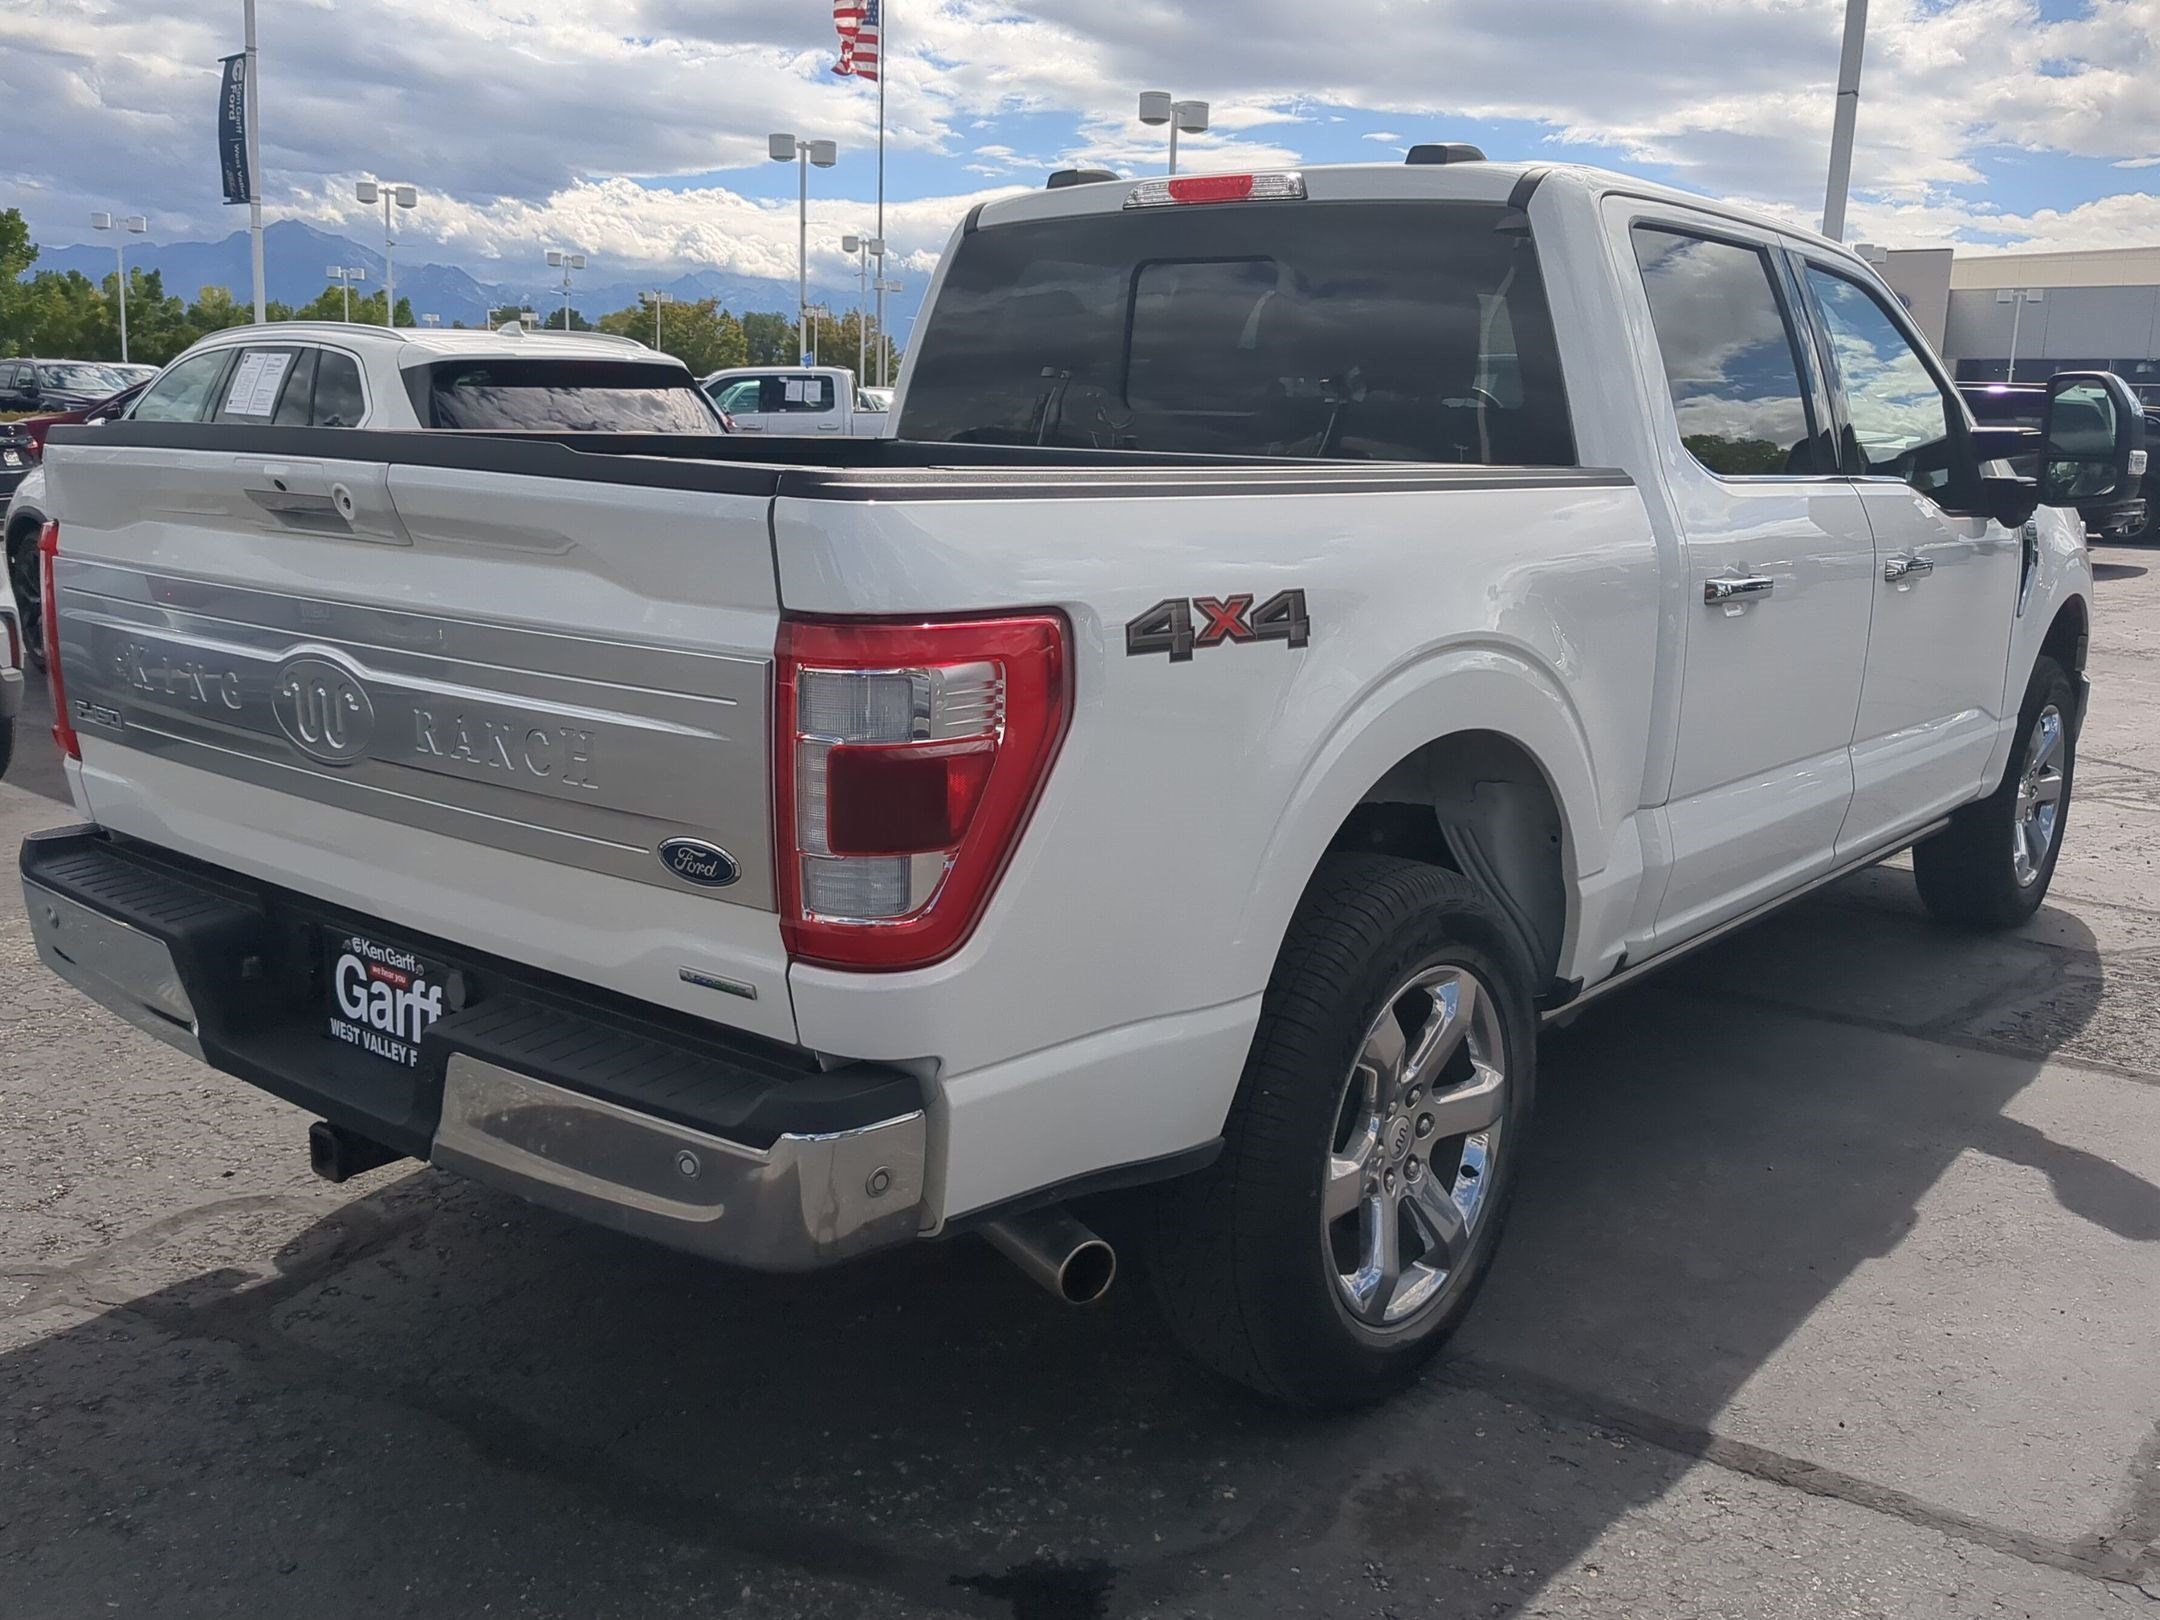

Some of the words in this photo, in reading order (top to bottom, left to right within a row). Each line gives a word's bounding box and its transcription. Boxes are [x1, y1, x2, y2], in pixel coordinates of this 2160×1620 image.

[229, 85, 237, 120] Ford
[413, 706, 600, 790] RANCH
[674, 846, 718, 878] Ford
[361, 939, 386, 962] Ken
[386, 948, 416, 973] Garff
[395, 974, 406, 984] you
[336, 954, 442, 1044] Garff
[330, 1017, 361, 1046] WEST
[363, 1030, 407, 1064] VALLEY
